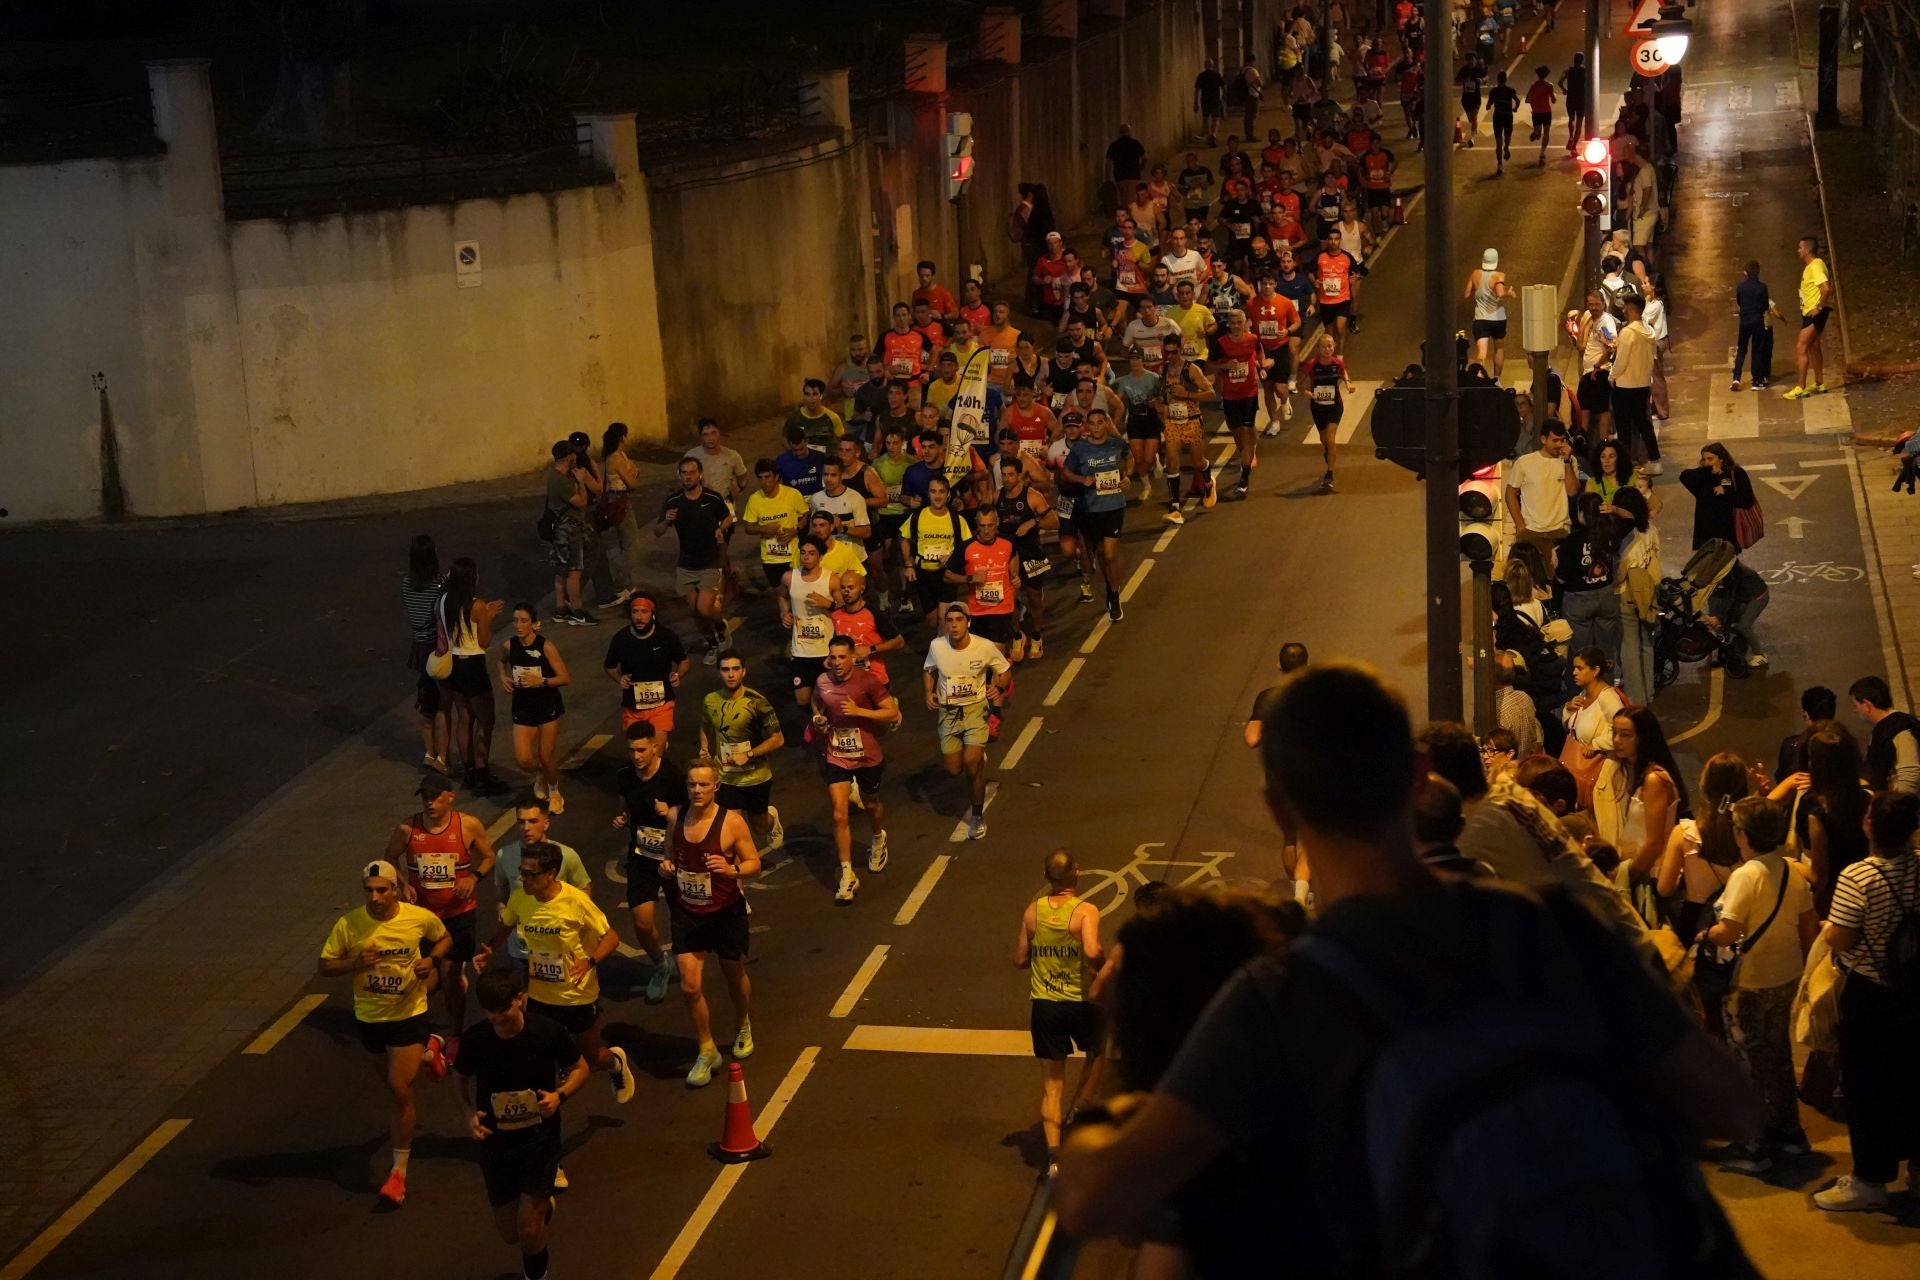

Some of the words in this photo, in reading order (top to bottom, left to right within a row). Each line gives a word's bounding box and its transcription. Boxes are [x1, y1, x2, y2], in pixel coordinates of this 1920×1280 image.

[1640, 50, 1663, 62] 30
[762, 513, 787, 521] GOLDCAR
[802, 625, 820, 633] 3020
[952, 684, 972, 692] 1347
[640, 691, 659, 699] 1591
[423, 865, 448, 875] 2301
[683, 882, 706, 892] 1212
[524, 925, 562, 935] GOLDCAR
[533, 961, 562, 975] 12103
[367, 974, 402, 986] 12100
[504, 1104, 527, 1115] 695
